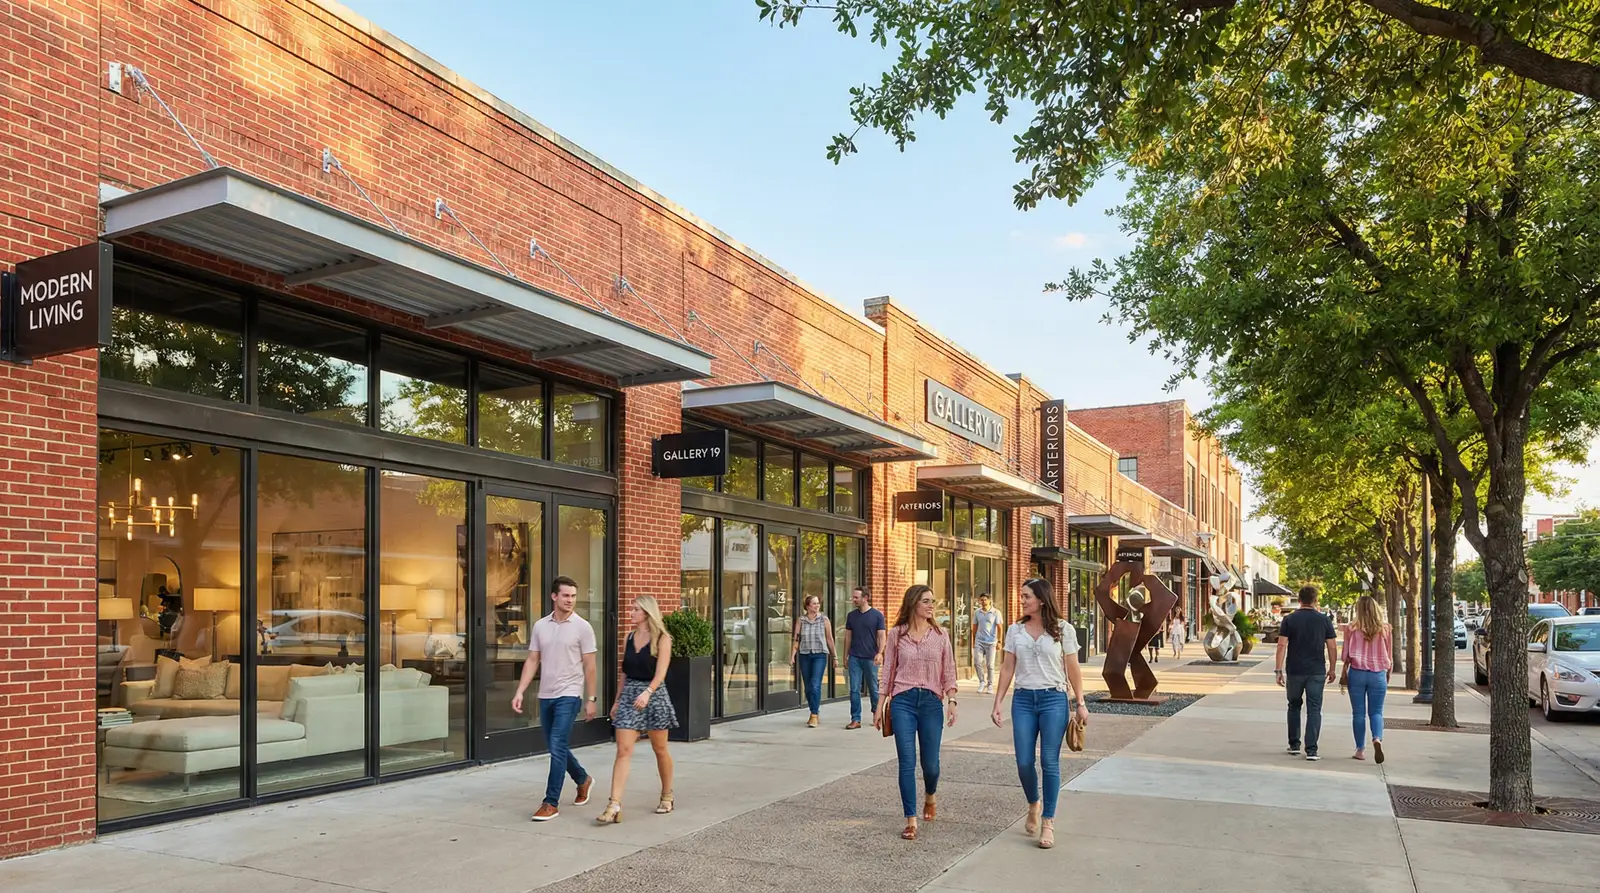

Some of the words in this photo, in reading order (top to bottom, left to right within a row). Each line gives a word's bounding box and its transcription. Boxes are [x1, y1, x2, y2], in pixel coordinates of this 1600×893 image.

[20, 270, 93, 305] MODERN
[30, 300, 84, 330] LIVING
[934, 391, 989, 439] GALLERY
[991, 419, 1003, 444] 19
[663, 447, 708, 461] GALLERY
[710, 447, 721, 458] 19
[1046, 405, 1059, 489] ARTERIORS
[899, 502, 942, 511] ARTERIORS
